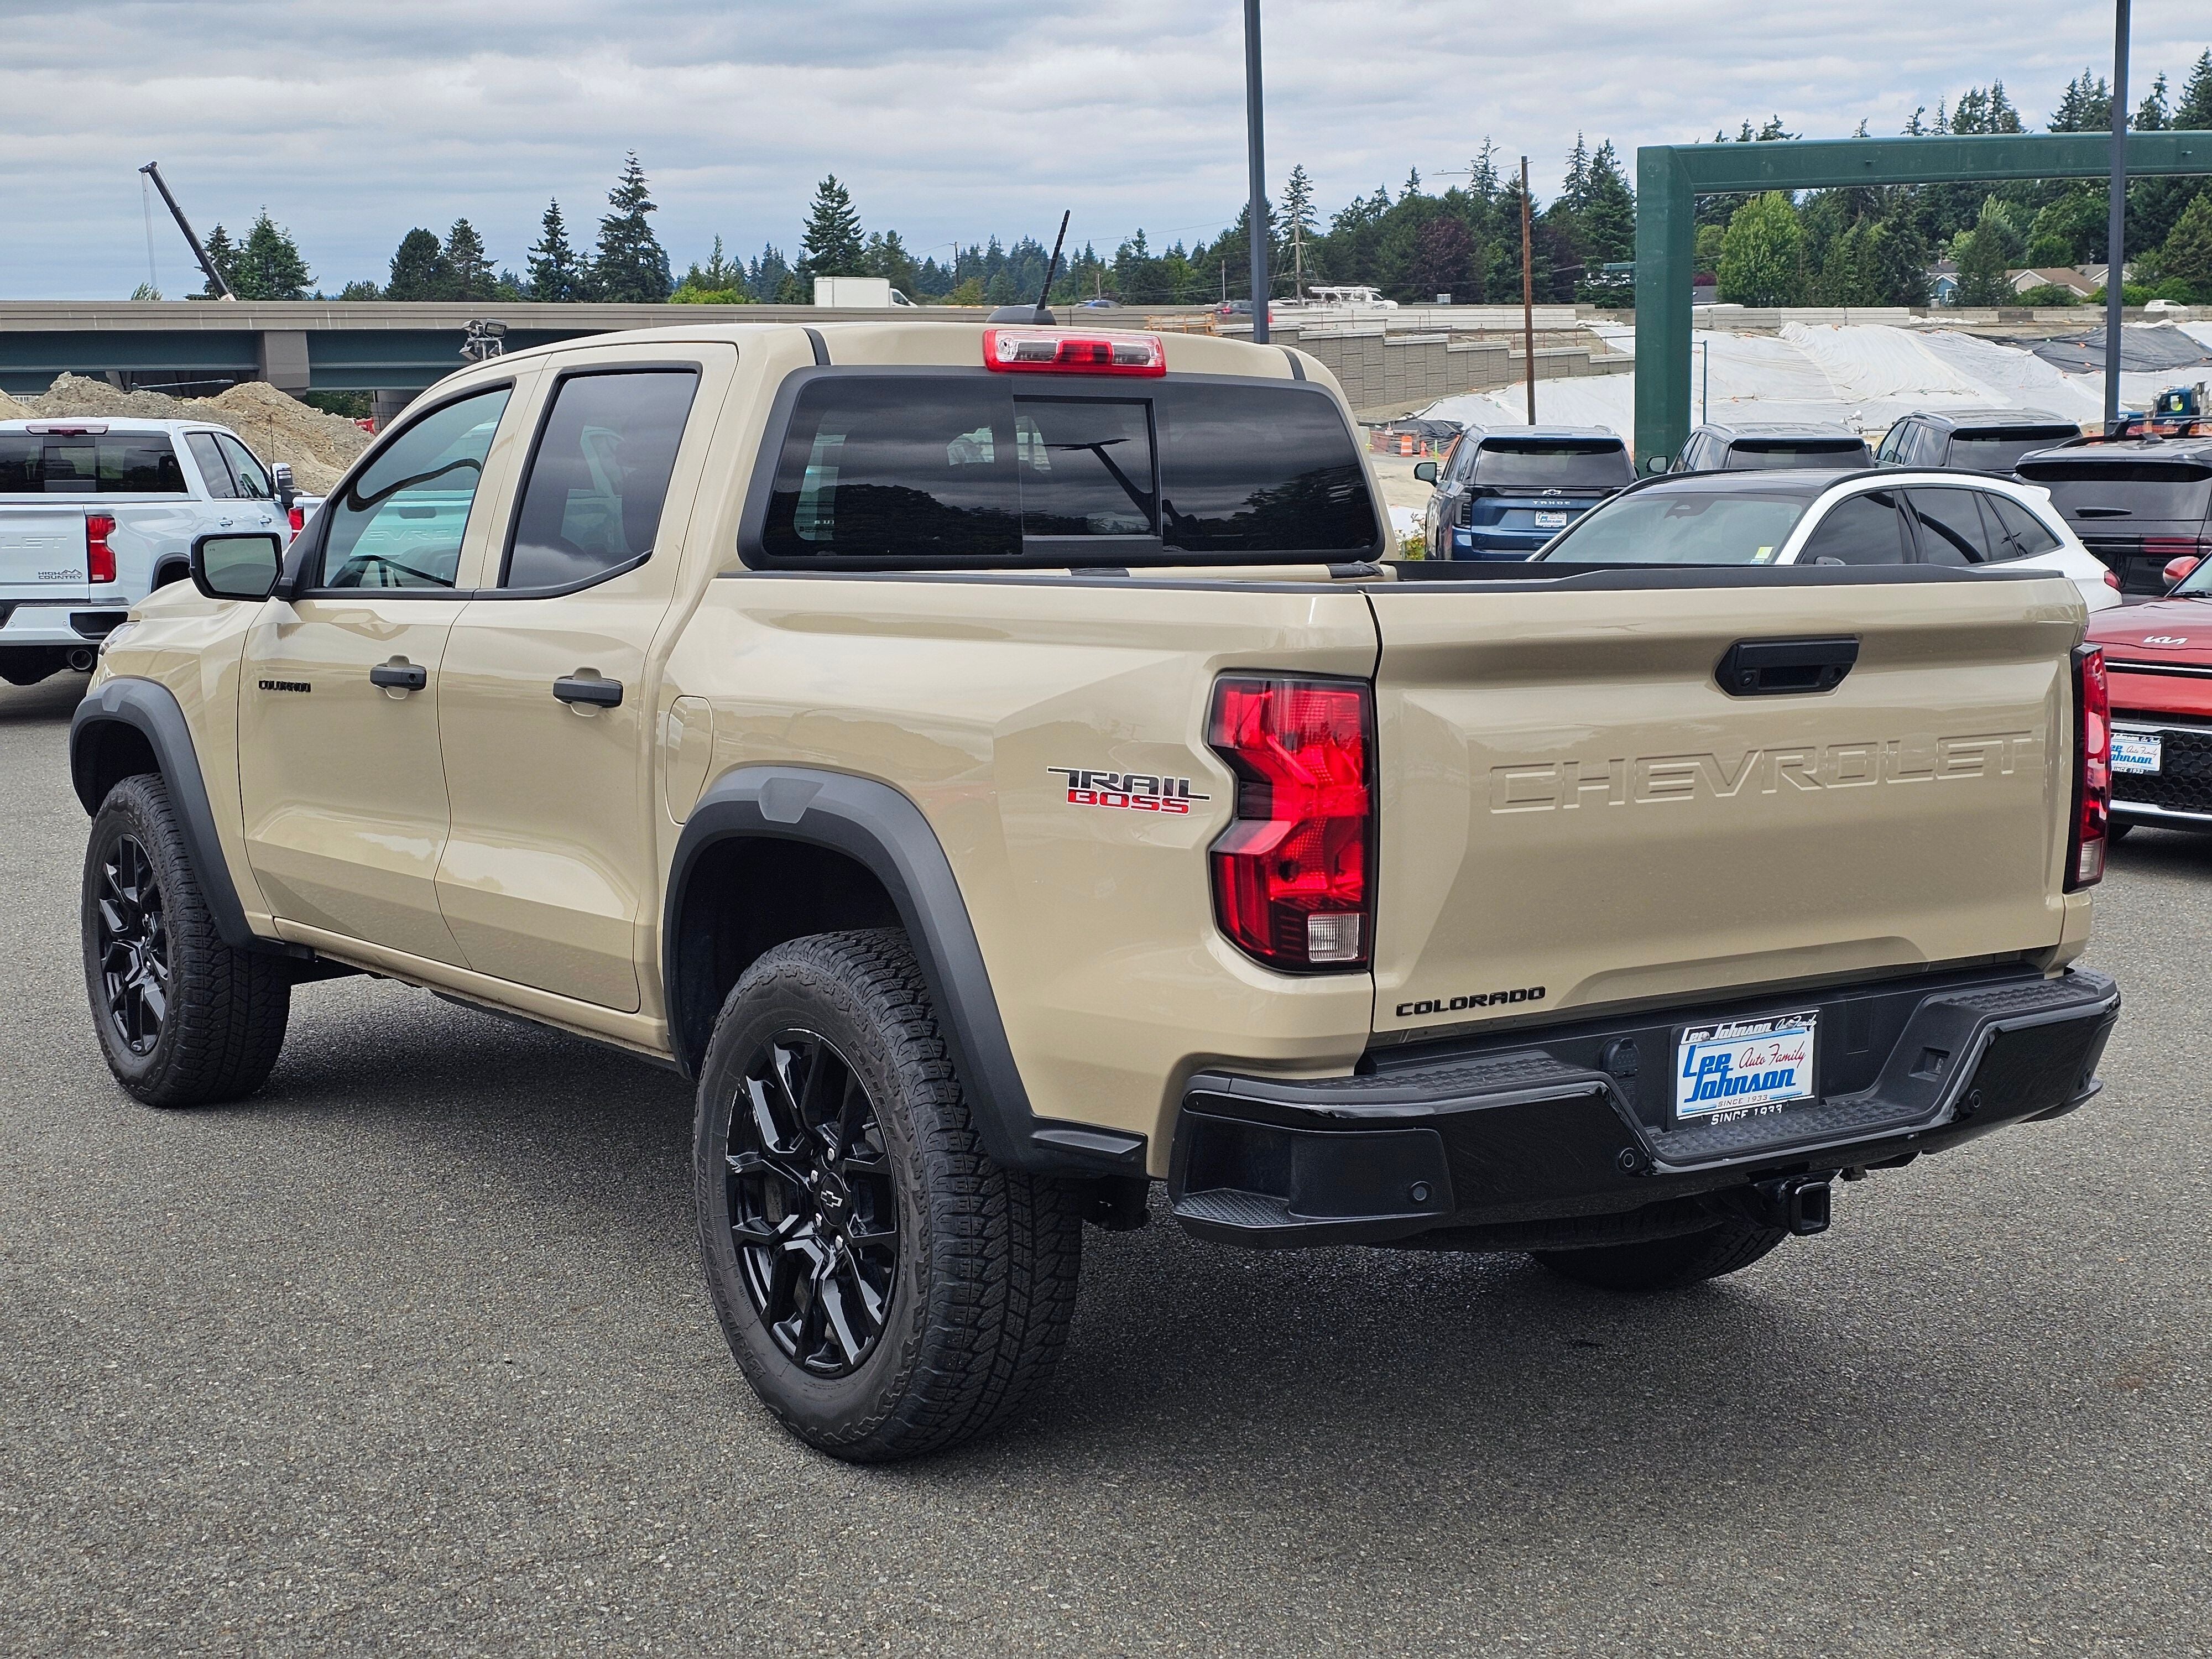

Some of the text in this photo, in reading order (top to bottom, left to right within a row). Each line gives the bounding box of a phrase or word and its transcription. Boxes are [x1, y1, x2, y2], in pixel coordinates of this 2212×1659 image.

[1047, 766, 1211, 801] TRAIL
[1489, 730, 2032, 814] CHEVROLET
[1067, 788, 1190, 815] BOSS
[1396, 986, 1546, 1017] COLORADO
[1710, 1021, 1772, 1041] Johnson
[1682, 1040, 1807, 1078] Lee Auto Family
[1683, 1064, 1797, 1103] Johnson
[1718, 1094, 1768, 1107] SINCE 1933
